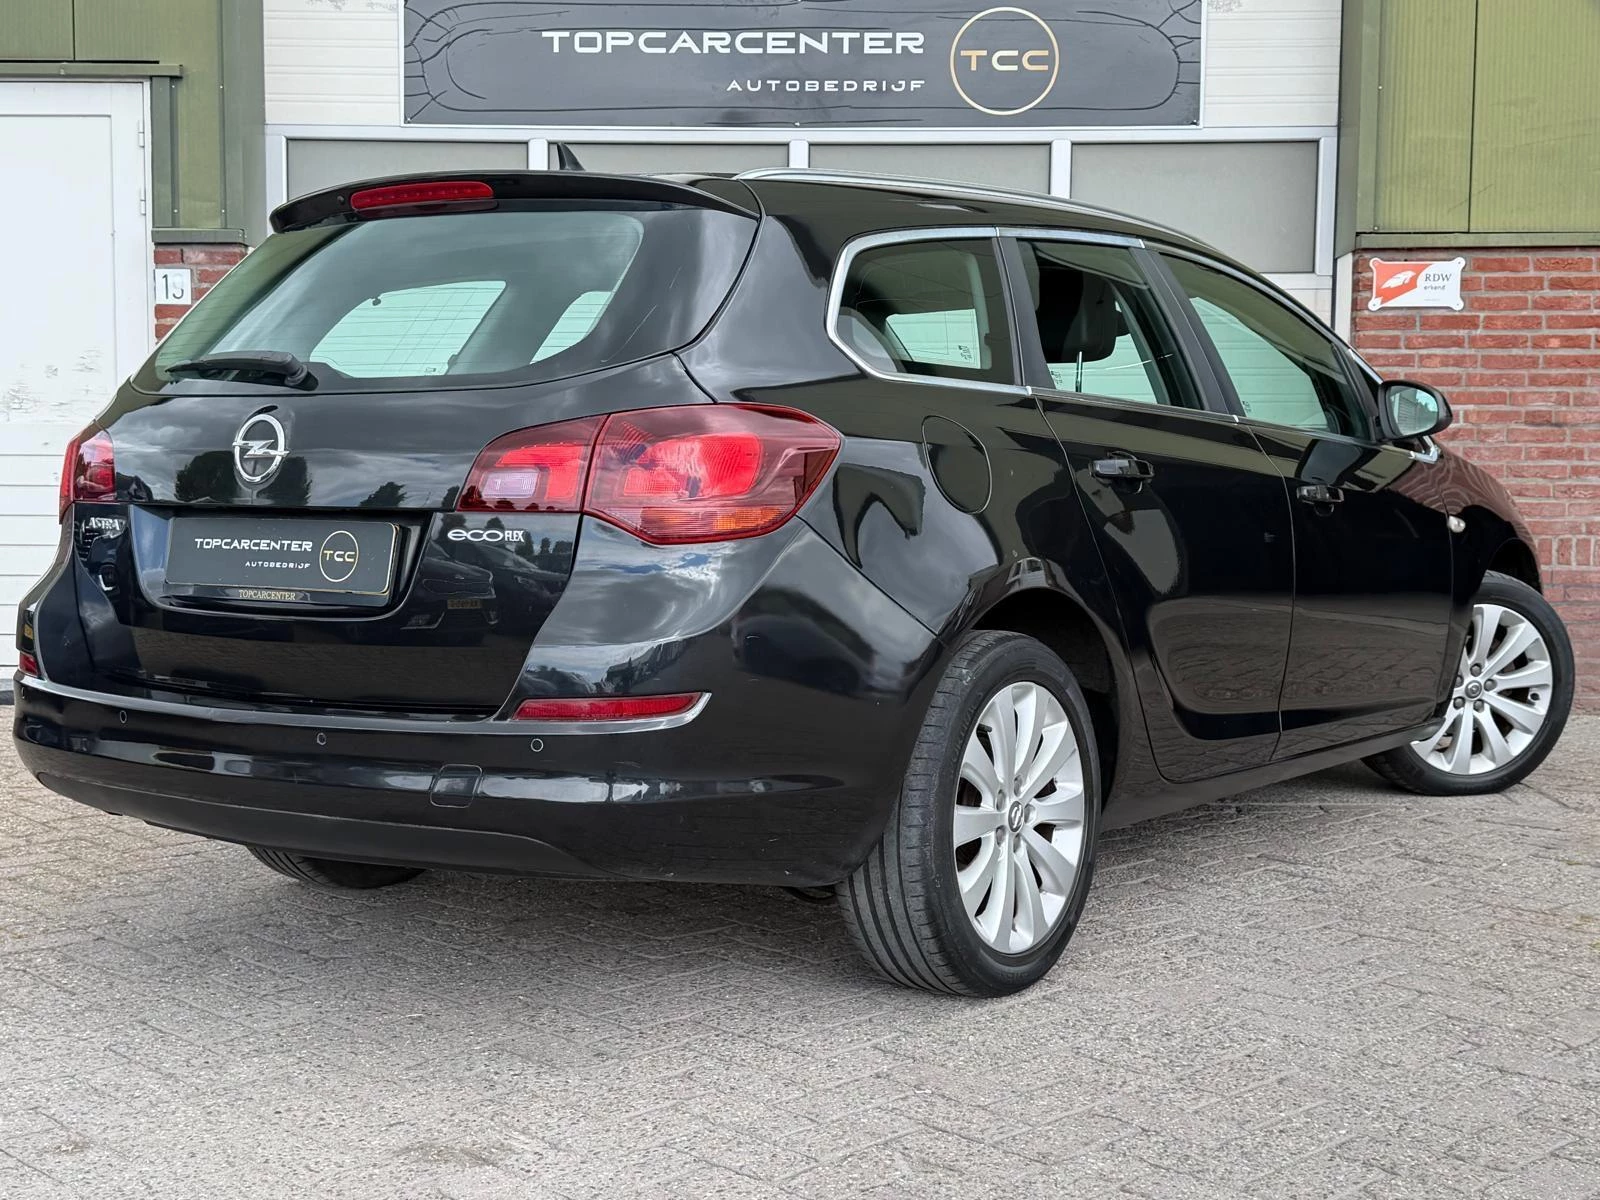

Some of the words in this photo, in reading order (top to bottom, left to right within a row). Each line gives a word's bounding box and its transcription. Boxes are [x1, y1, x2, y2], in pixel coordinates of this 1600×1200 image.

[541, 31, 925, 54] TOPCARCENTER
[960, 50, 1049, 71] TCC
[726, 80, 926, 92] AUTOBEDRIJF
[1424, 273, 1452, 281] RDW
[195, 538, 313, 552] TOPCARCENTER
[323, 550, 356, 562] TCC
[245, 561, 311, 569] AUTOBEDRIJF
[238, 589, 296, 601] TOPCARCENTER
